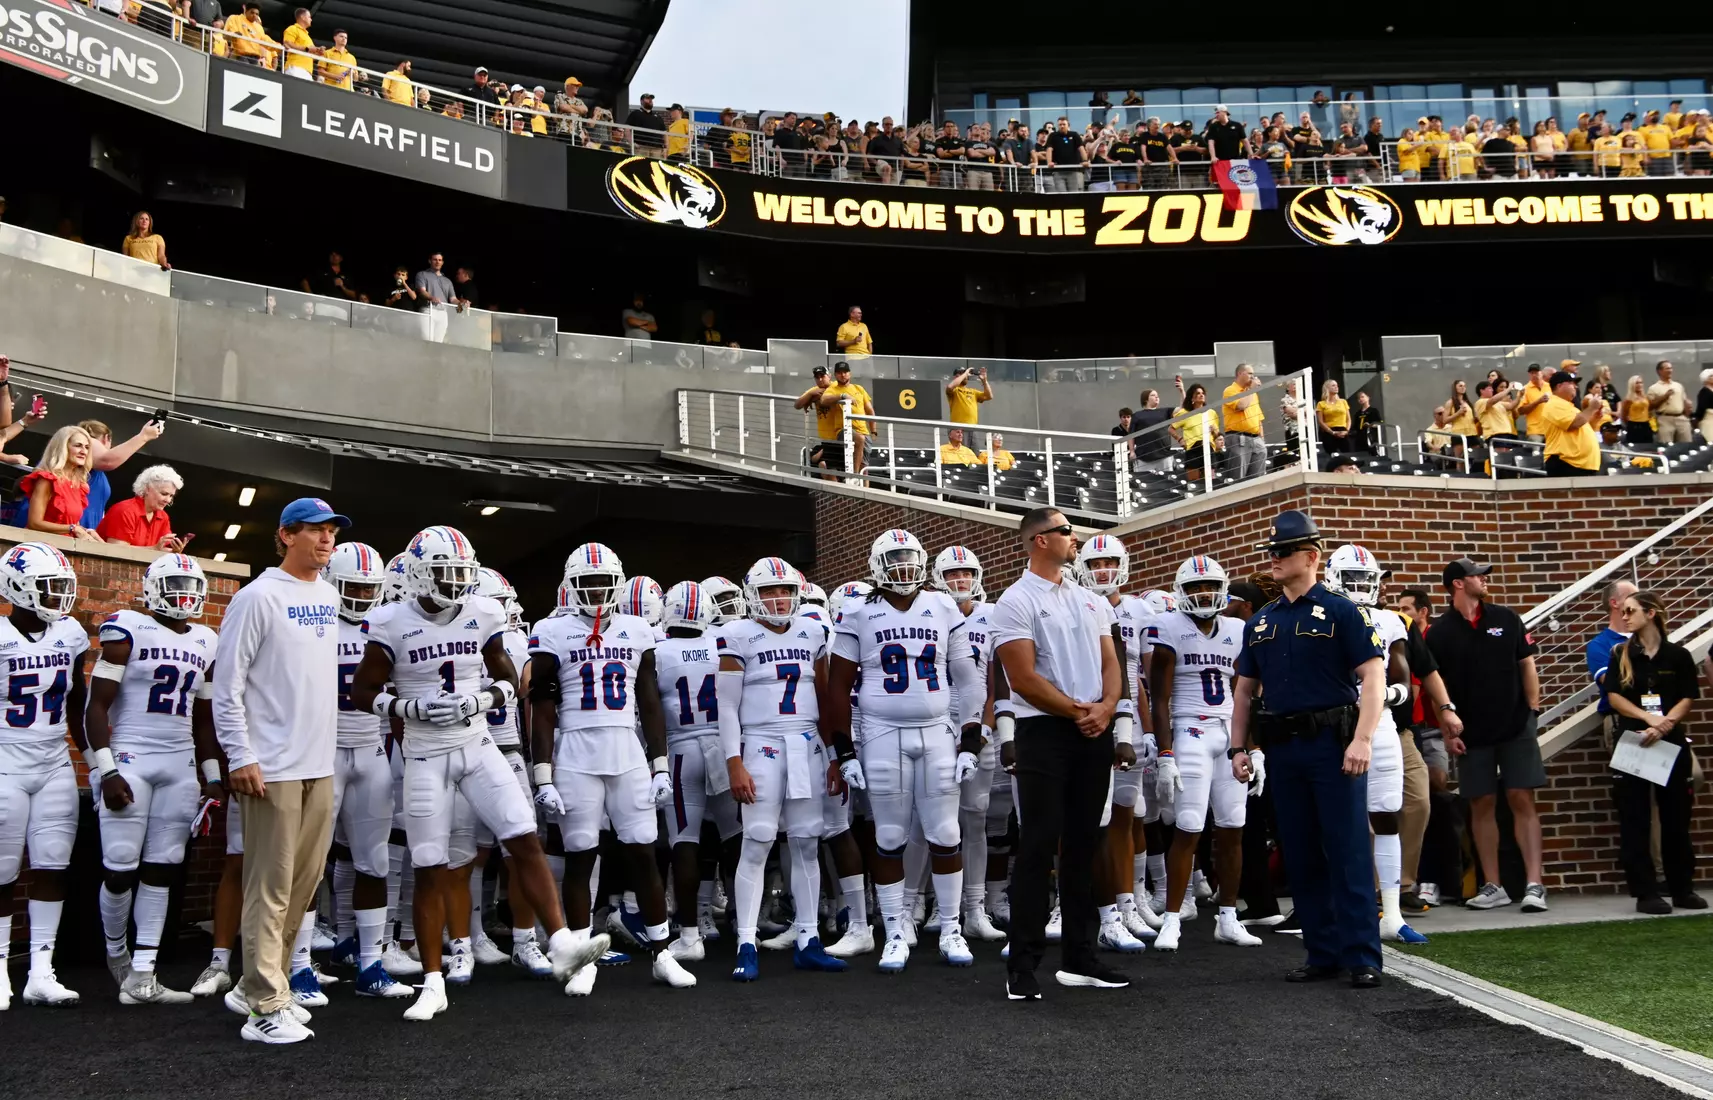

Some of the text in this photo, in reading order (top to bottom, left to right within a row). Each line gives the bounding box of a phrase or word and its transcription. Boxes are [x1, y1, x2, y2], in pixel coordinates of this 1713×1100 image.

[301, 104, 495, 173] LEARFIELD
[753, 191, 1253, 246] WELCOME TO THE ZOU
[1415, 195, 1604, 227] WELCOME
[1609, 193, 1660, 222] TO
[1383, 373, 1391, 384] 5
[898, 388, 917, 410] 6
[298, 617, 335, 626] FOOTBALL
[402, 629, 423, 640] C-USA
[874, 627, 938, 643] BULLDOGS
[8, 653, 70, 672] BULLDOGS
[138, 648, 206, 671] BULLDOGS
[408, 641, 478, 664] BULLDOGS
[570, 647, 633, 663] BULLDOGS
[682, 649, 710, 662] OKORIE
[757, 648, 811, 664] BULLDOGS
[1183, 653, 1233, 668] BULLDOGS
[438, 660, 455, 693] 1
[880, 643, 940, 694] 94
[146, 664, 197, 717] 21
[579, 661, 627, 711] 10
[775, 662, 801, 715] 7
[1199, 667, 1226, 706] 0
[5, 669, 67, 728] 54
[675, 674, 718, 726] 14
